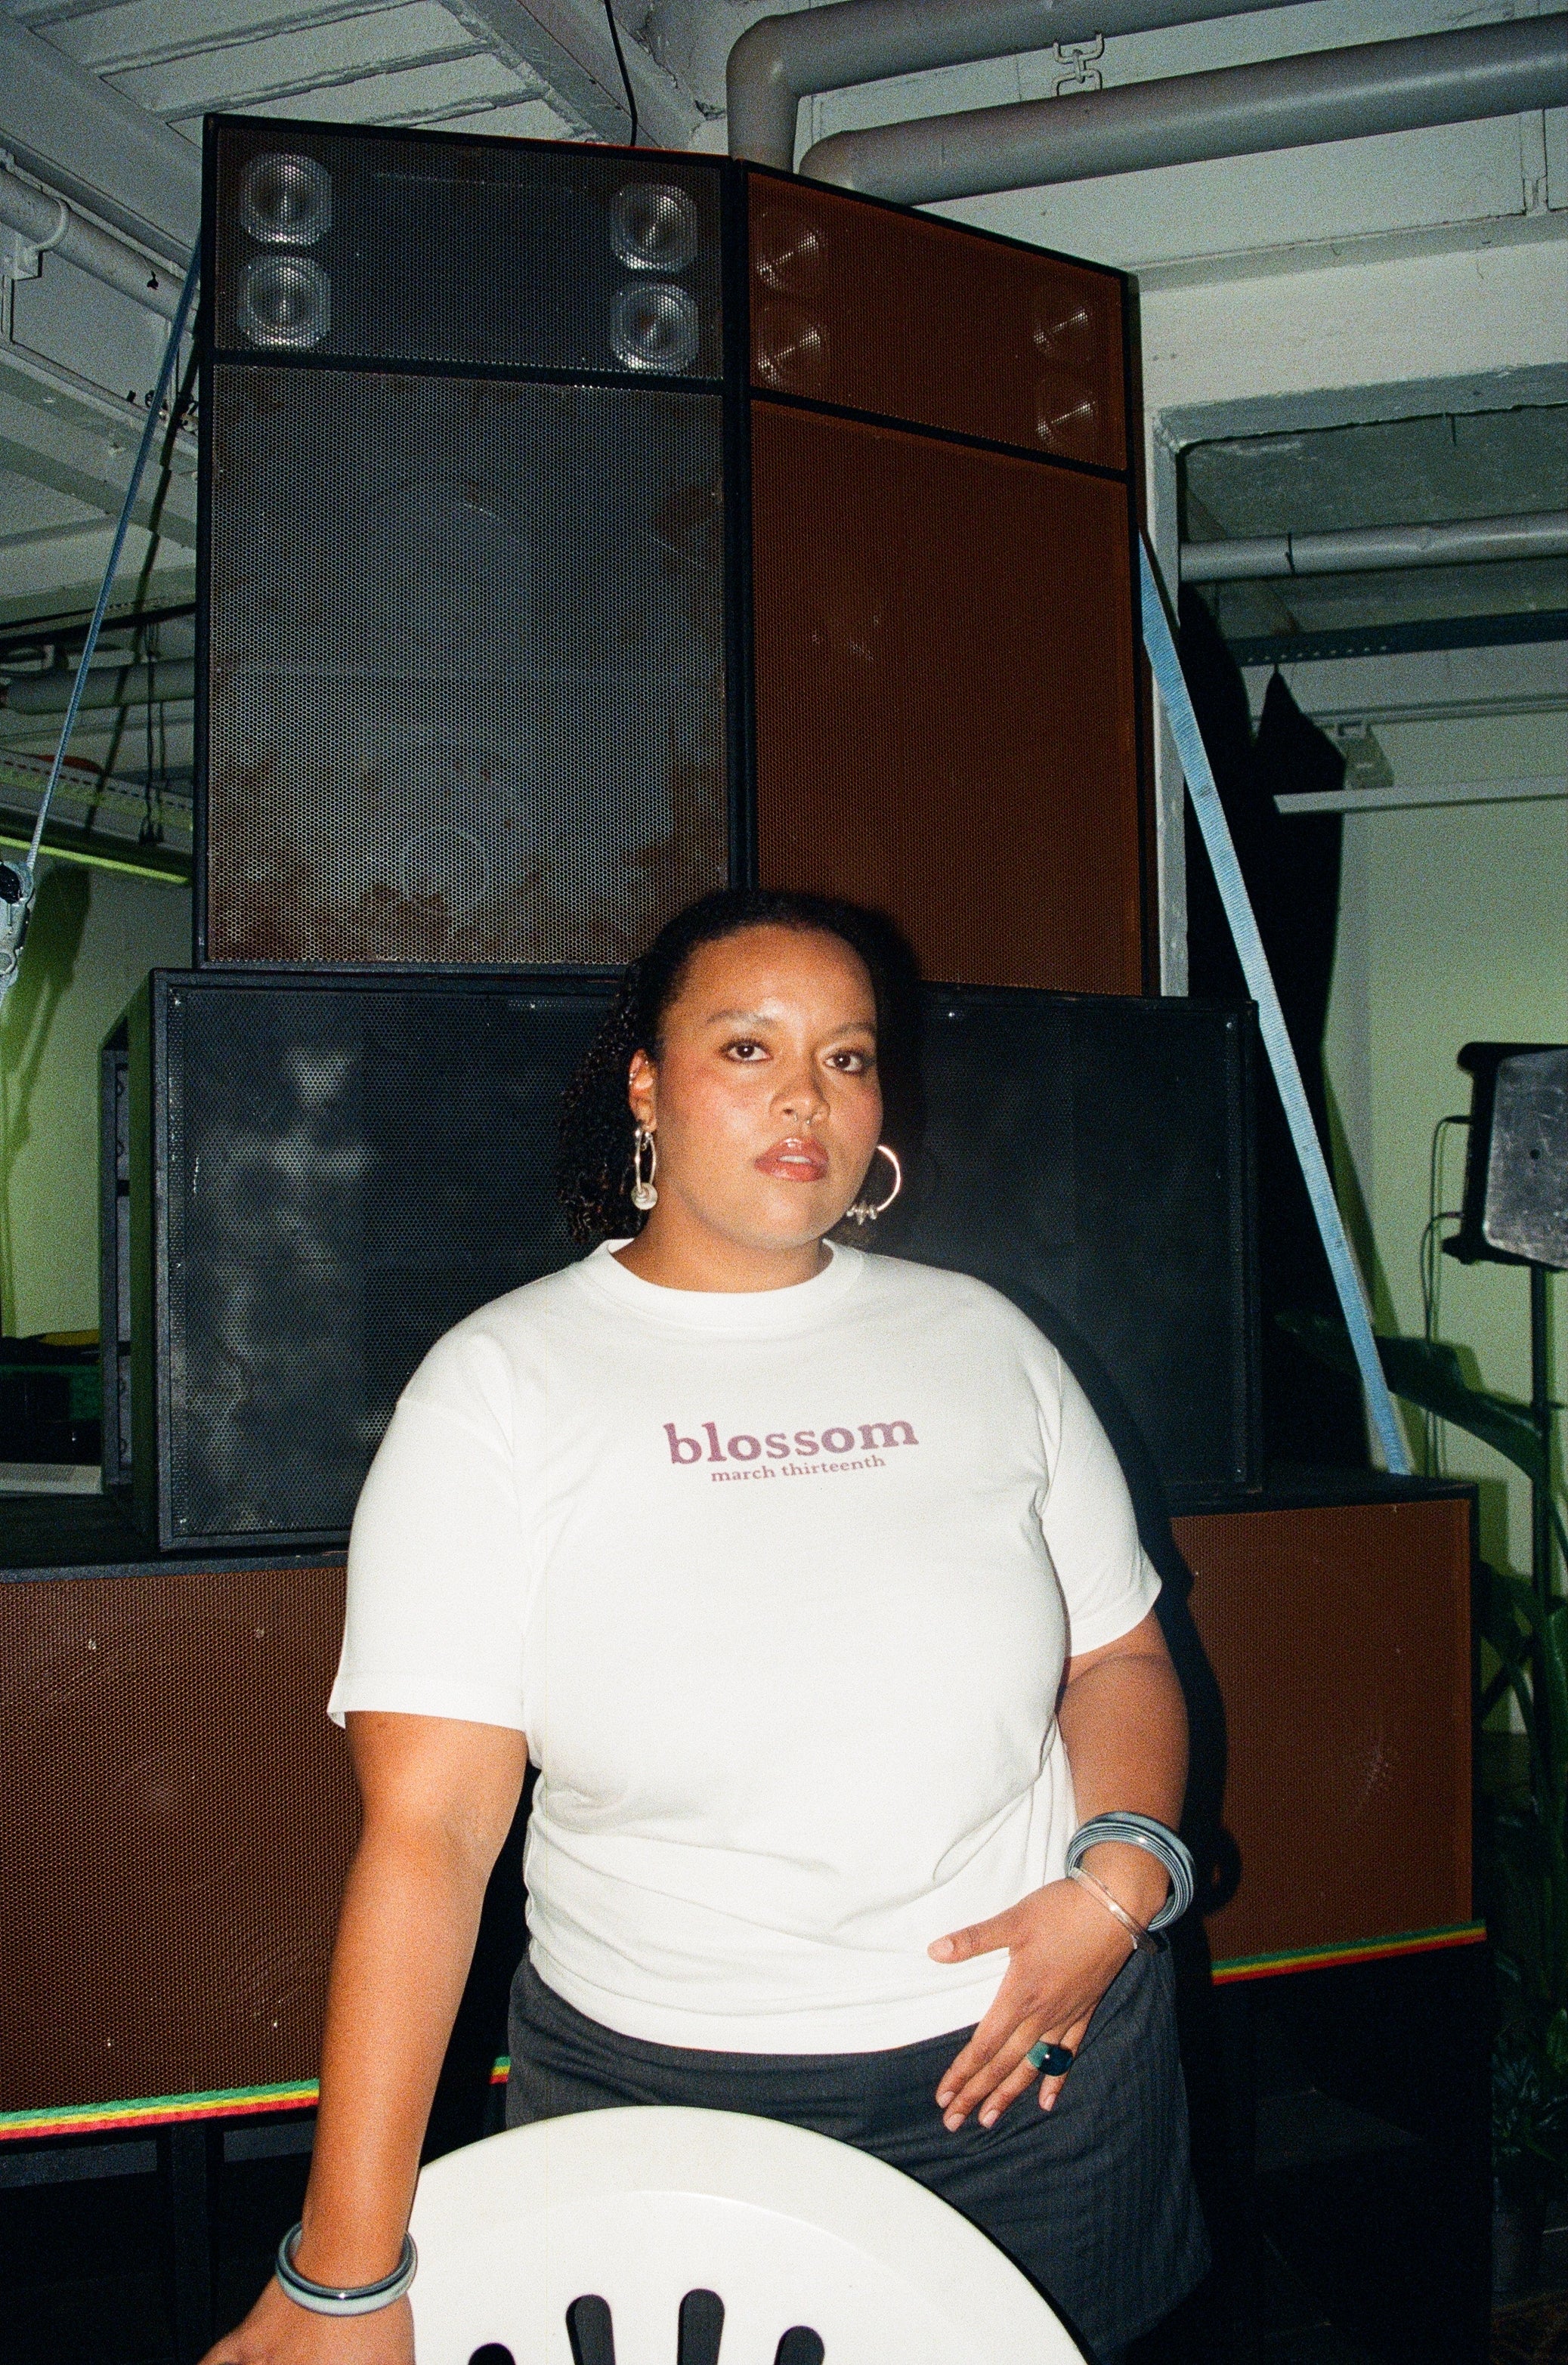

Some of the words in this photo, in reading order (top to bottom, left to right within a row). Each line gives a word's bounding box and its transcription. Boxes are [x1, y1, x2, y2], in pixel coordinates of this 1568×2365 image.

[663, 1420, 919, 1464] blossom
[711, 1465, 776, 1482] march
[781, 1455, 886, 1476] thirteenth
